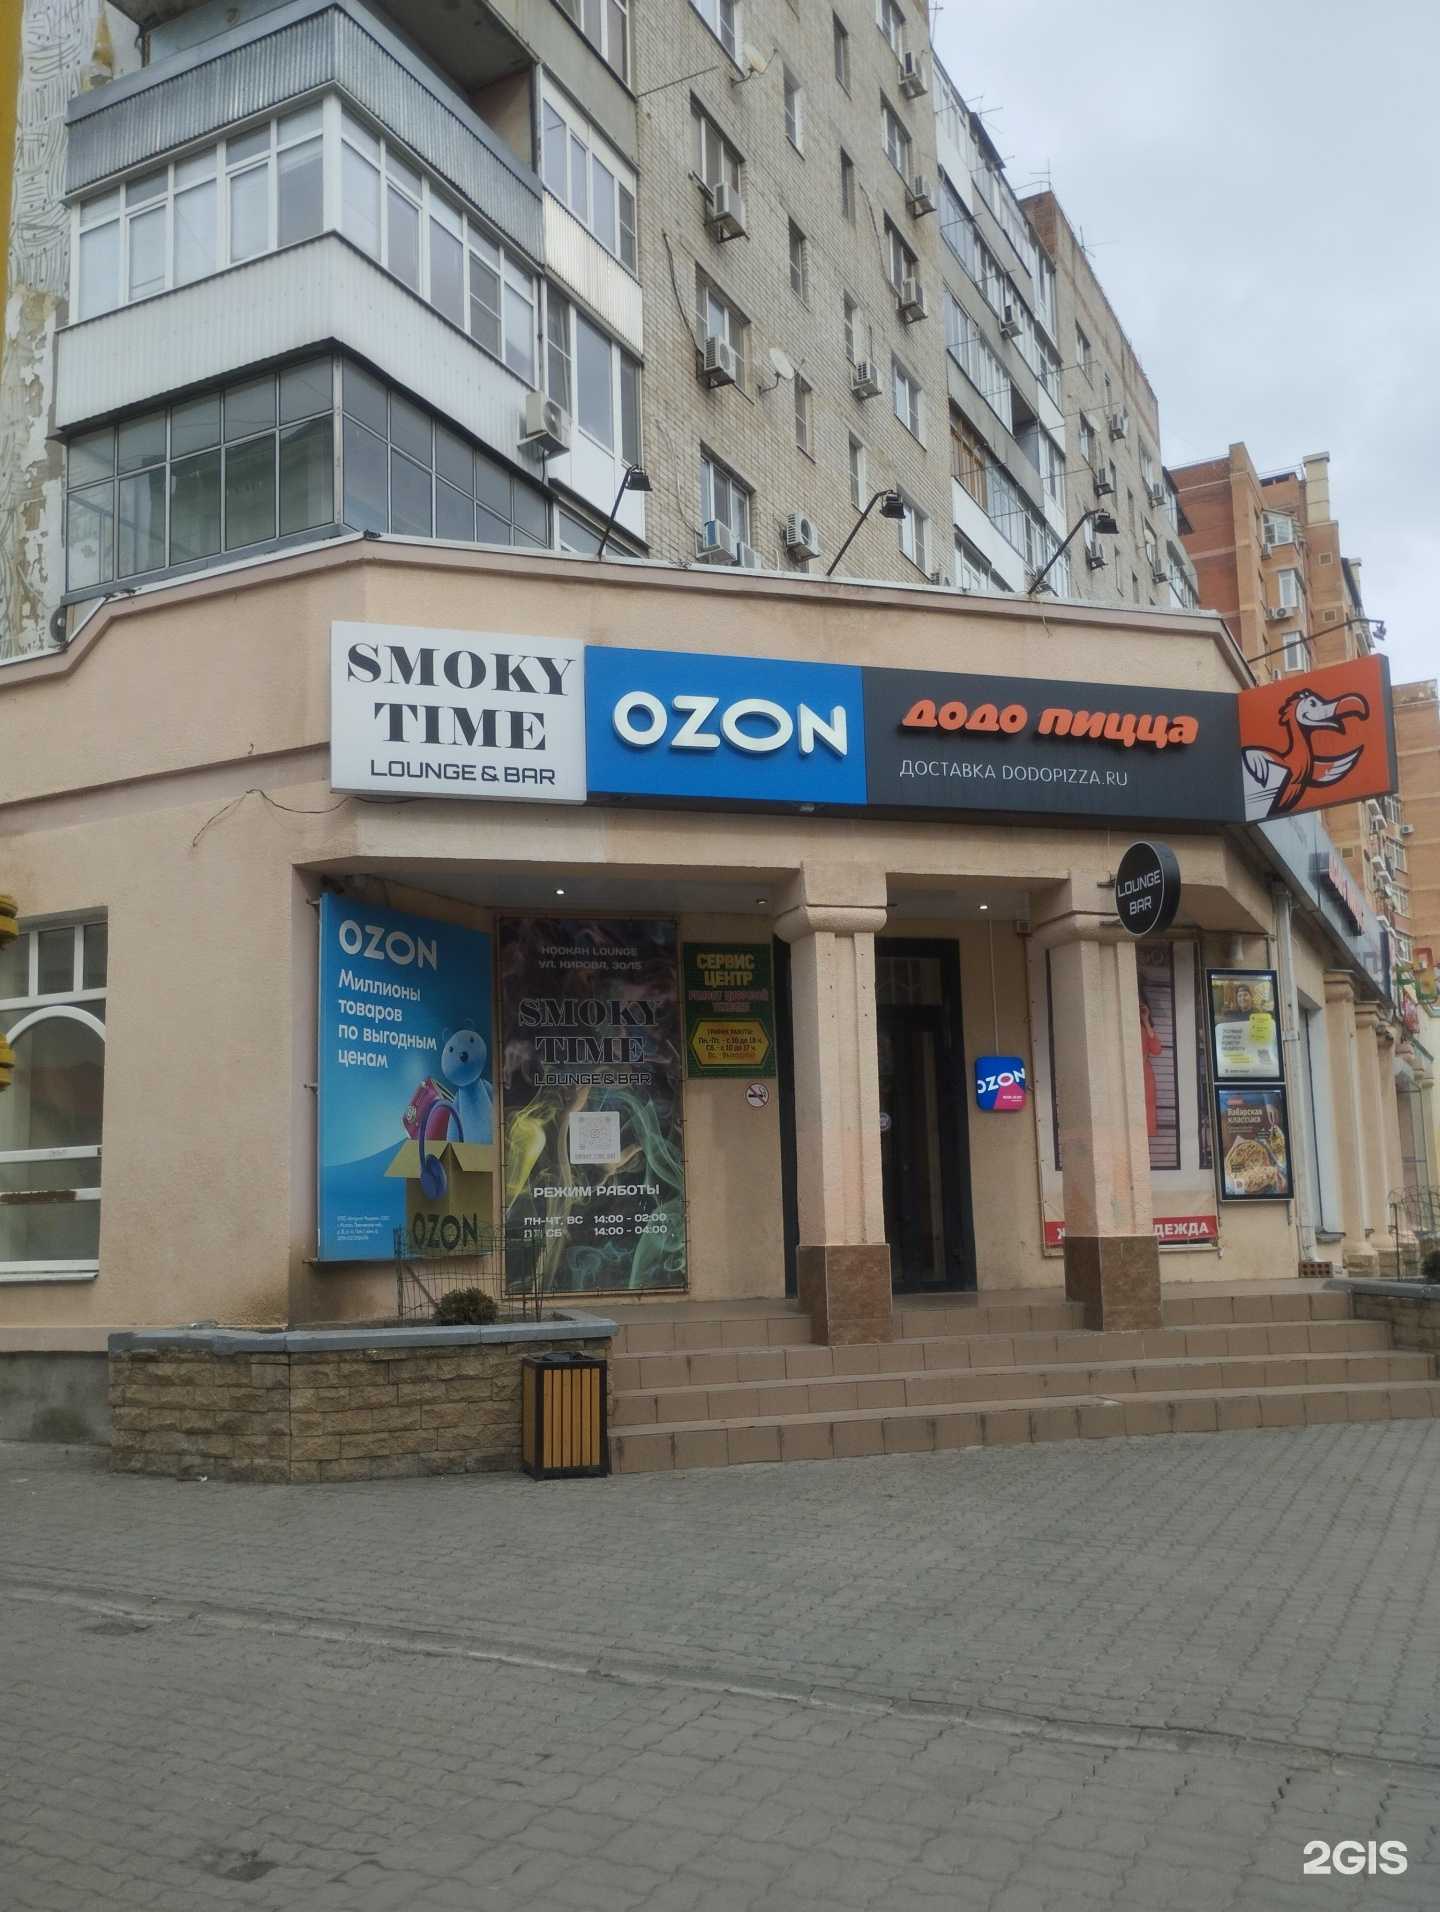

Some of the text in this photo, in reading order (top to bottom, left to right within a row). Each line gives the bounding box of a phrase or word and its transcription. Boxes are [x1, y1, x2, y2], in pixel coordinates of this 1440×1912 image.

[347, 642, 577, 696] SMOKY
[374, 702, 547, 751] TIME
[612, 690, 849, 759] OZON
[899, 759, 1128, 786] ДОСТАВКА DODOPIZZA.RU
[1117, 869, 1161, 898] LOUNGE
[1129, 895, 1152, 916] BAR
[338, 919, 438, 971] OZON
[696, 953, 755, 970] СЕРВИС
[338, 968, 421, 1002] Миллионы
[703, 970, 753, 988] ЦЕНТР
[338, 999, 403, 1023] товаров
[518, 998, 659, 1027] SMOKY
[338, 1024, 437, 1050] по выгодным
[535, 1036, 645, 1065] TIME
[338, 1050, 389, 1069] ценам
[977, 1067, 1026, 1094] OZON
[533, 1183, 660, 1199] РЕЖИМ РАБОТЫ
[412, 1212, 479, 1250] OZON
[545, 1228, 563, 1238] СБ
[593, 1226, 624, 1236] 14:00
[634, 1225, 668, 1235] 04:00
[566, 1215, 584, 1225] ВС
[593, 1214, 624, 1224] 14:00
[634, 1213, 667, 1223] 02:00
[1152, 1221, 1209, 1238] ДЕЖДА
